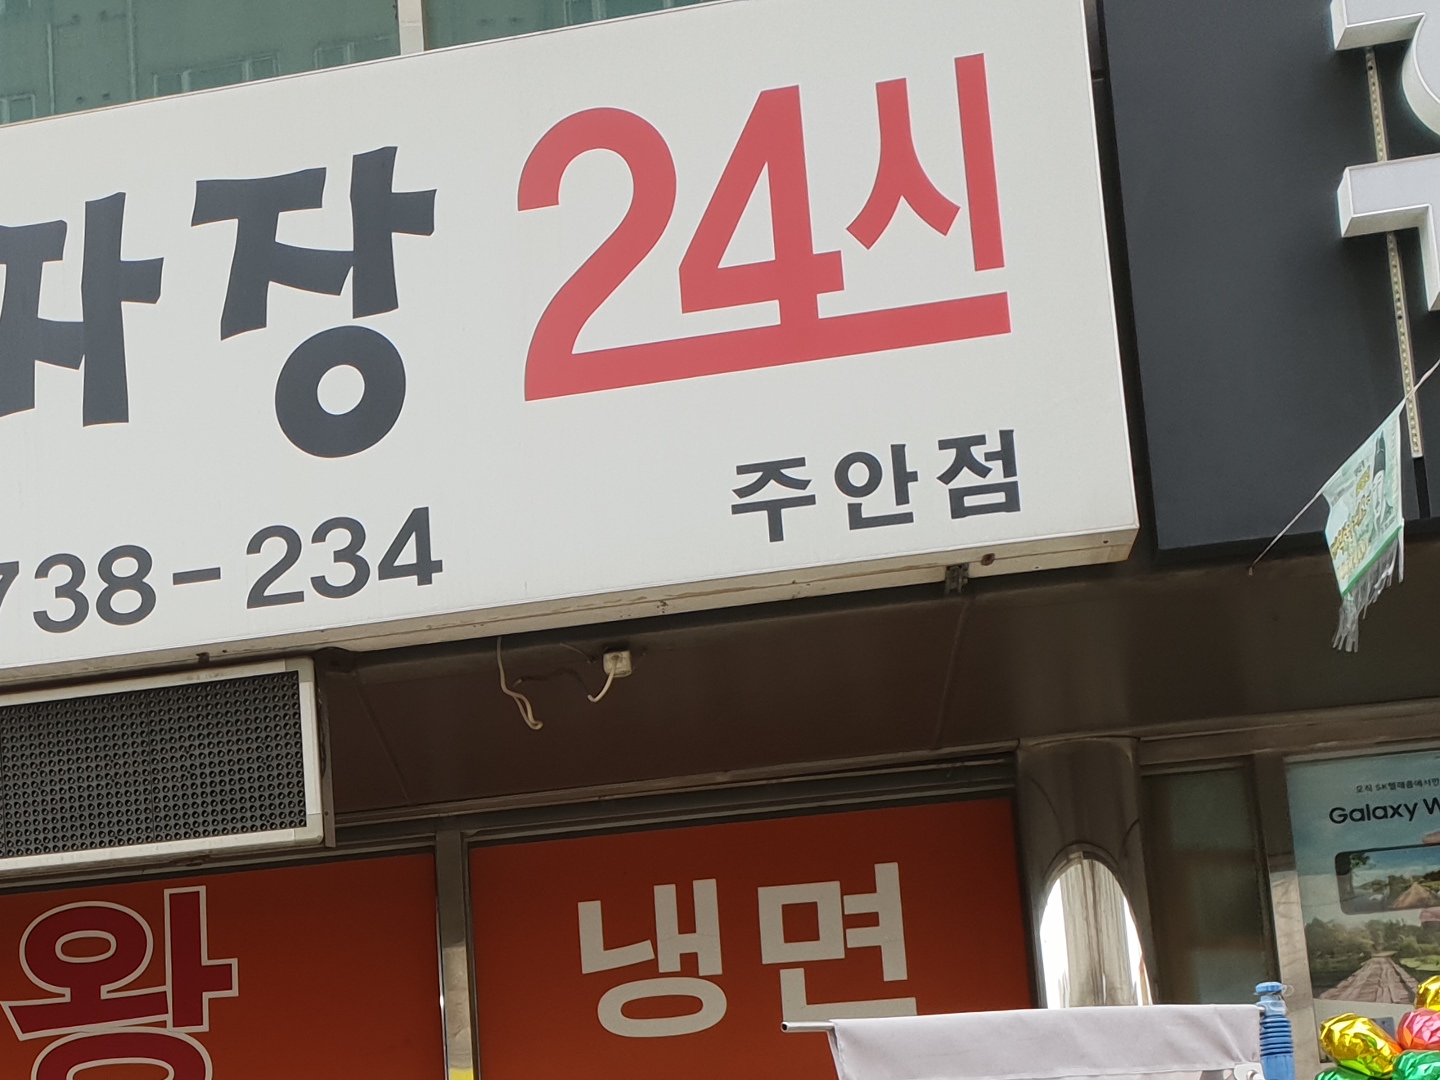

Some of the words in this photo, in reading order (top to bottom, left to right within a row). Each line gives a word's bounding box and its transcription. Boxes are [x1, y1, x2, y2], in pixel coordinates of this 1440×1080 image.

[517, 52, 1011, 401] 24시
[730, 429, 1023, 542] 주안점
[1329, 803, 1418, 824] Galaxy
[578, 862, 917, 1038] 냉면
